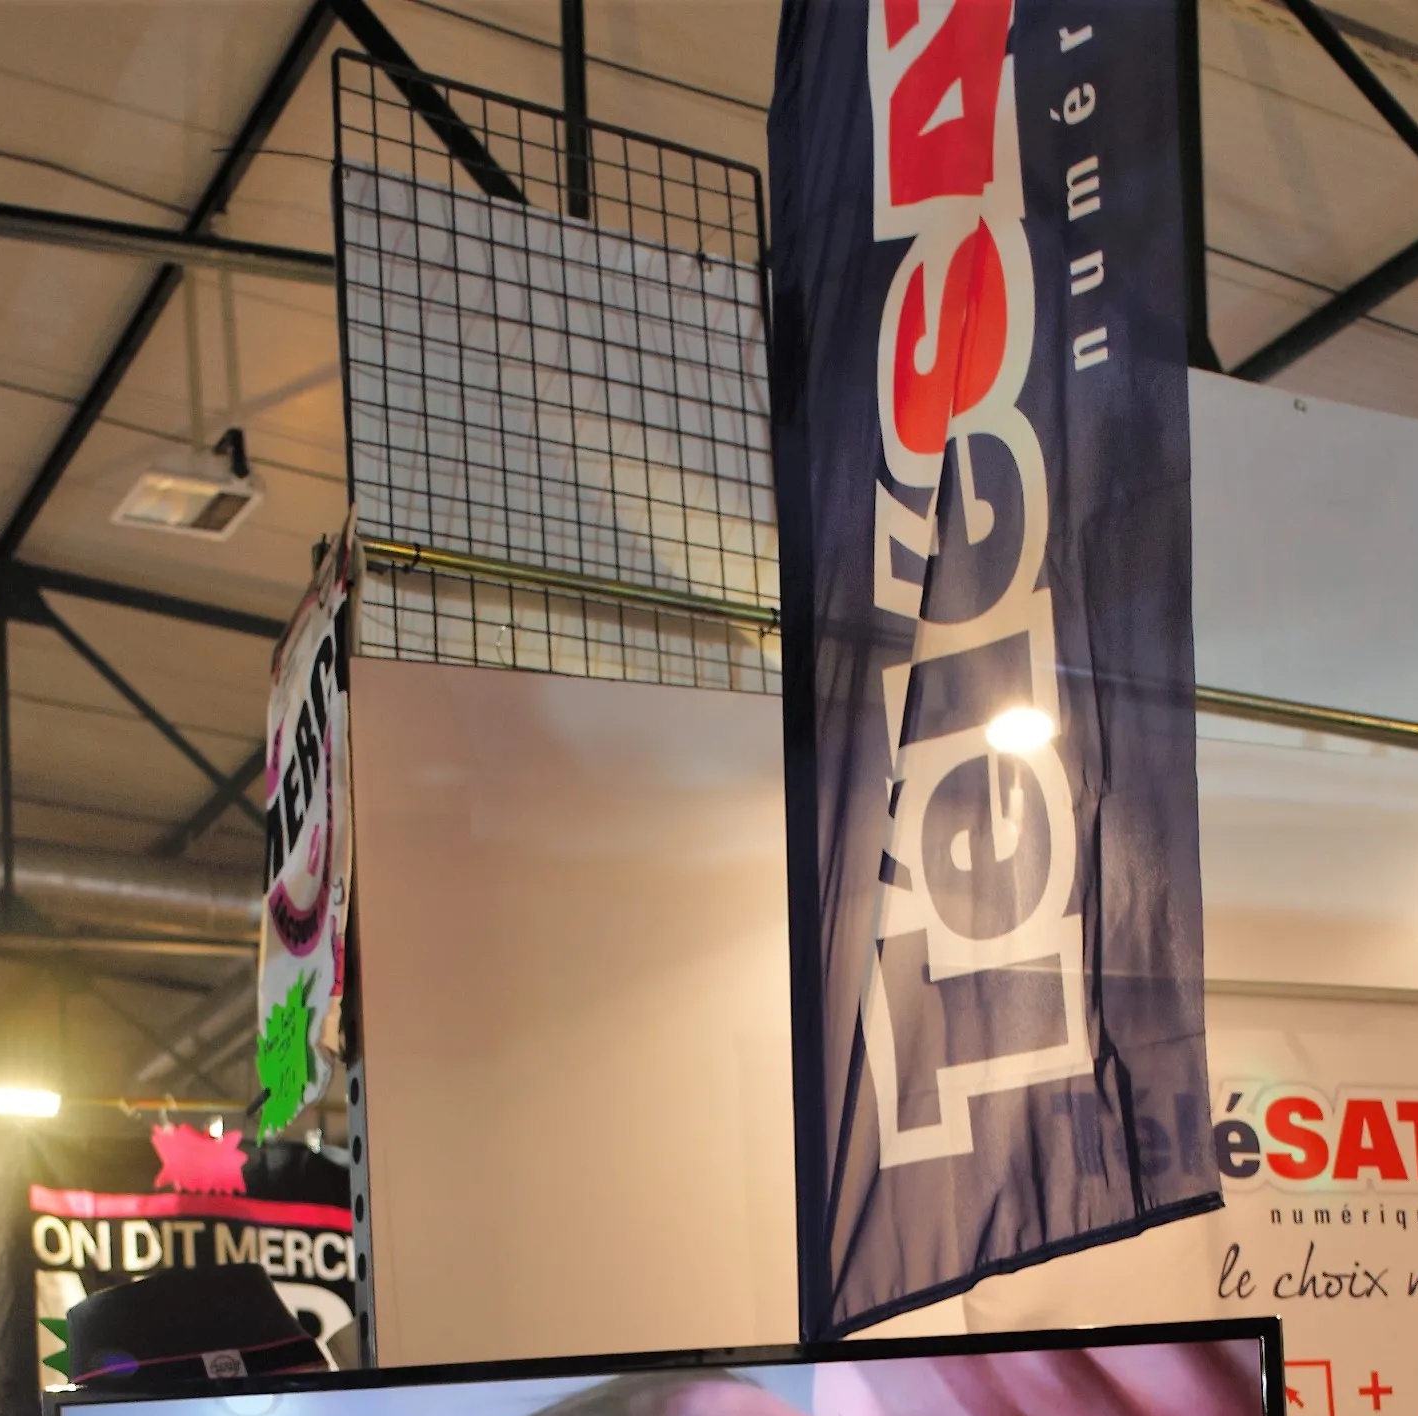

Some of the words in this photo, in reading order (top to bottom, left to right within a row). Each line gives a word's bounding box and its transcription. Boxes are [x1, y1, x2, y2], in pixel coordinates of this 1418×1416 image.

[32, 1214, 112, 1271] ON
[121, 1219, 206, 1271] DIT
[1218, 1242, 1257, 1299] le
[1273, 1240, 1389, 1300] choix
